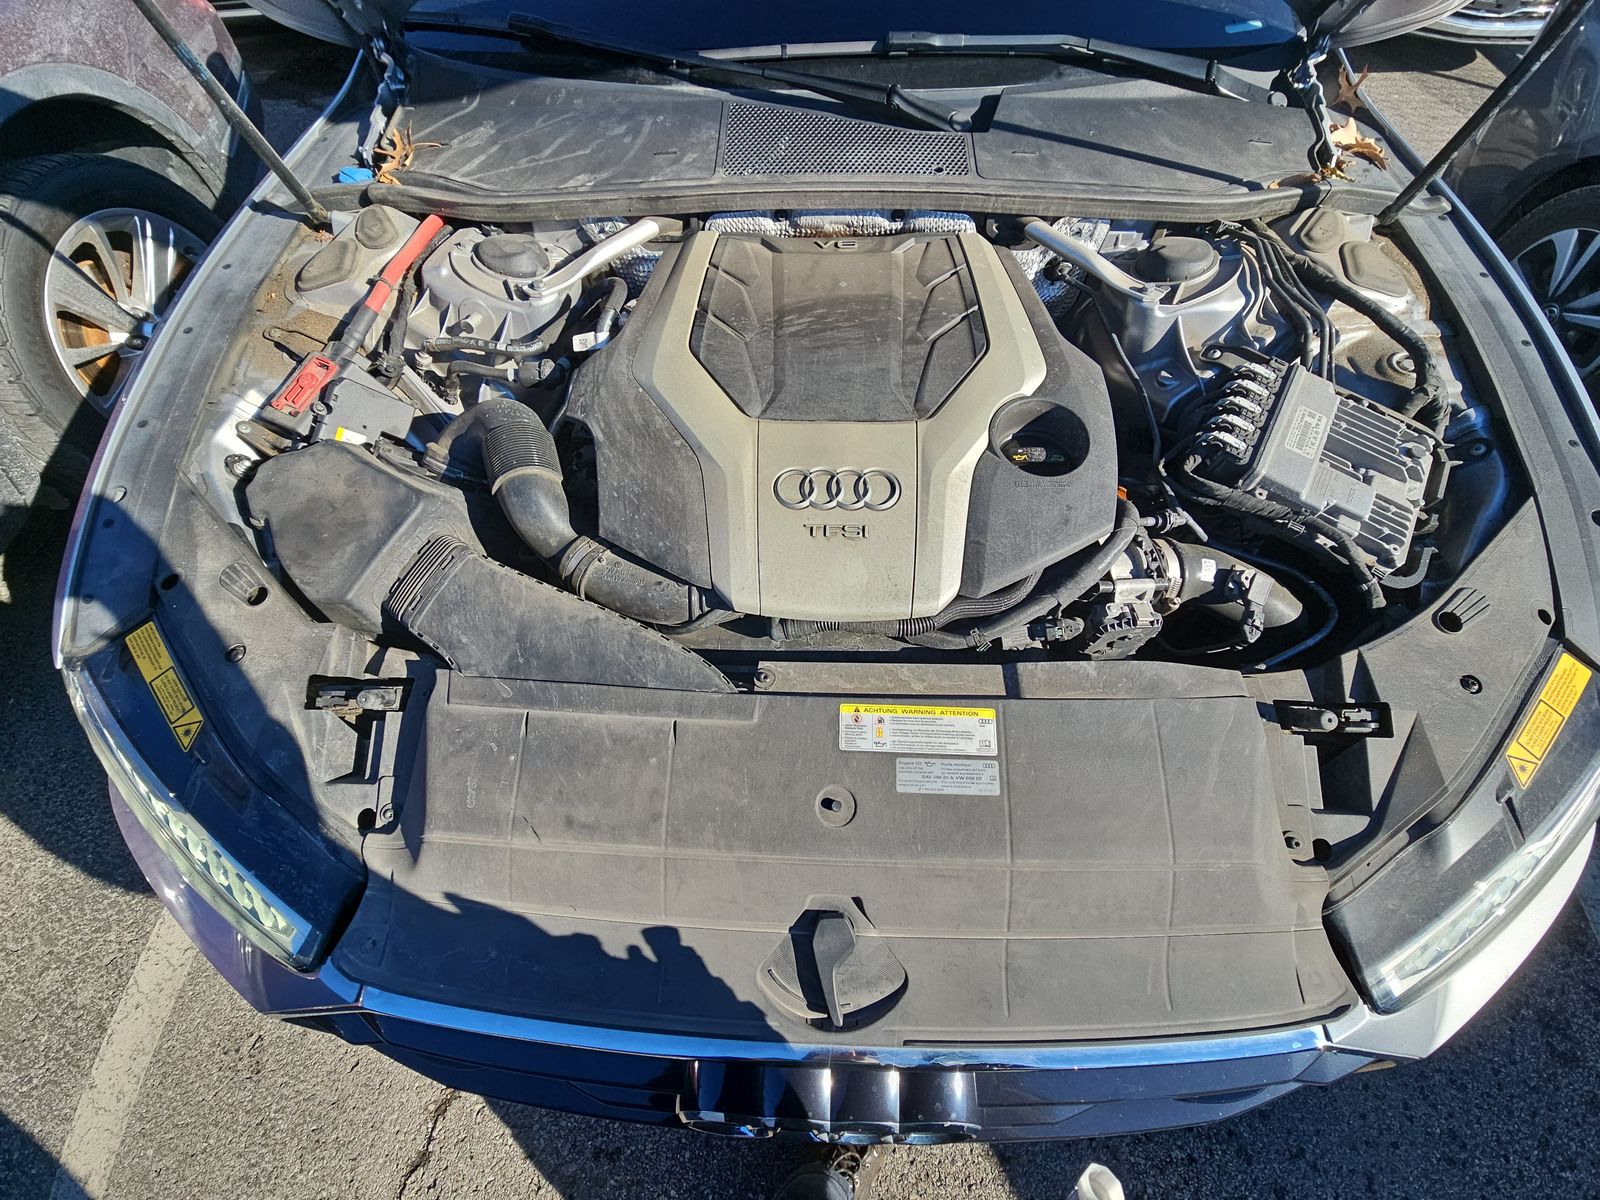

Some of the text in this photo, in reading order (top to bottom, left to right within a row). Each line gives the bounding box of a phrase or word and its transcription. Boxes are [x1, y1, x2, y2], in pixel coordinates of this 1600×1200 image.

[813, 240, 858, 250] V6
[802, 523, 870, 539] TFSI
[863, 707, 898, 715] ACHTUNG
[901, 708, 936, 716] WARNING
